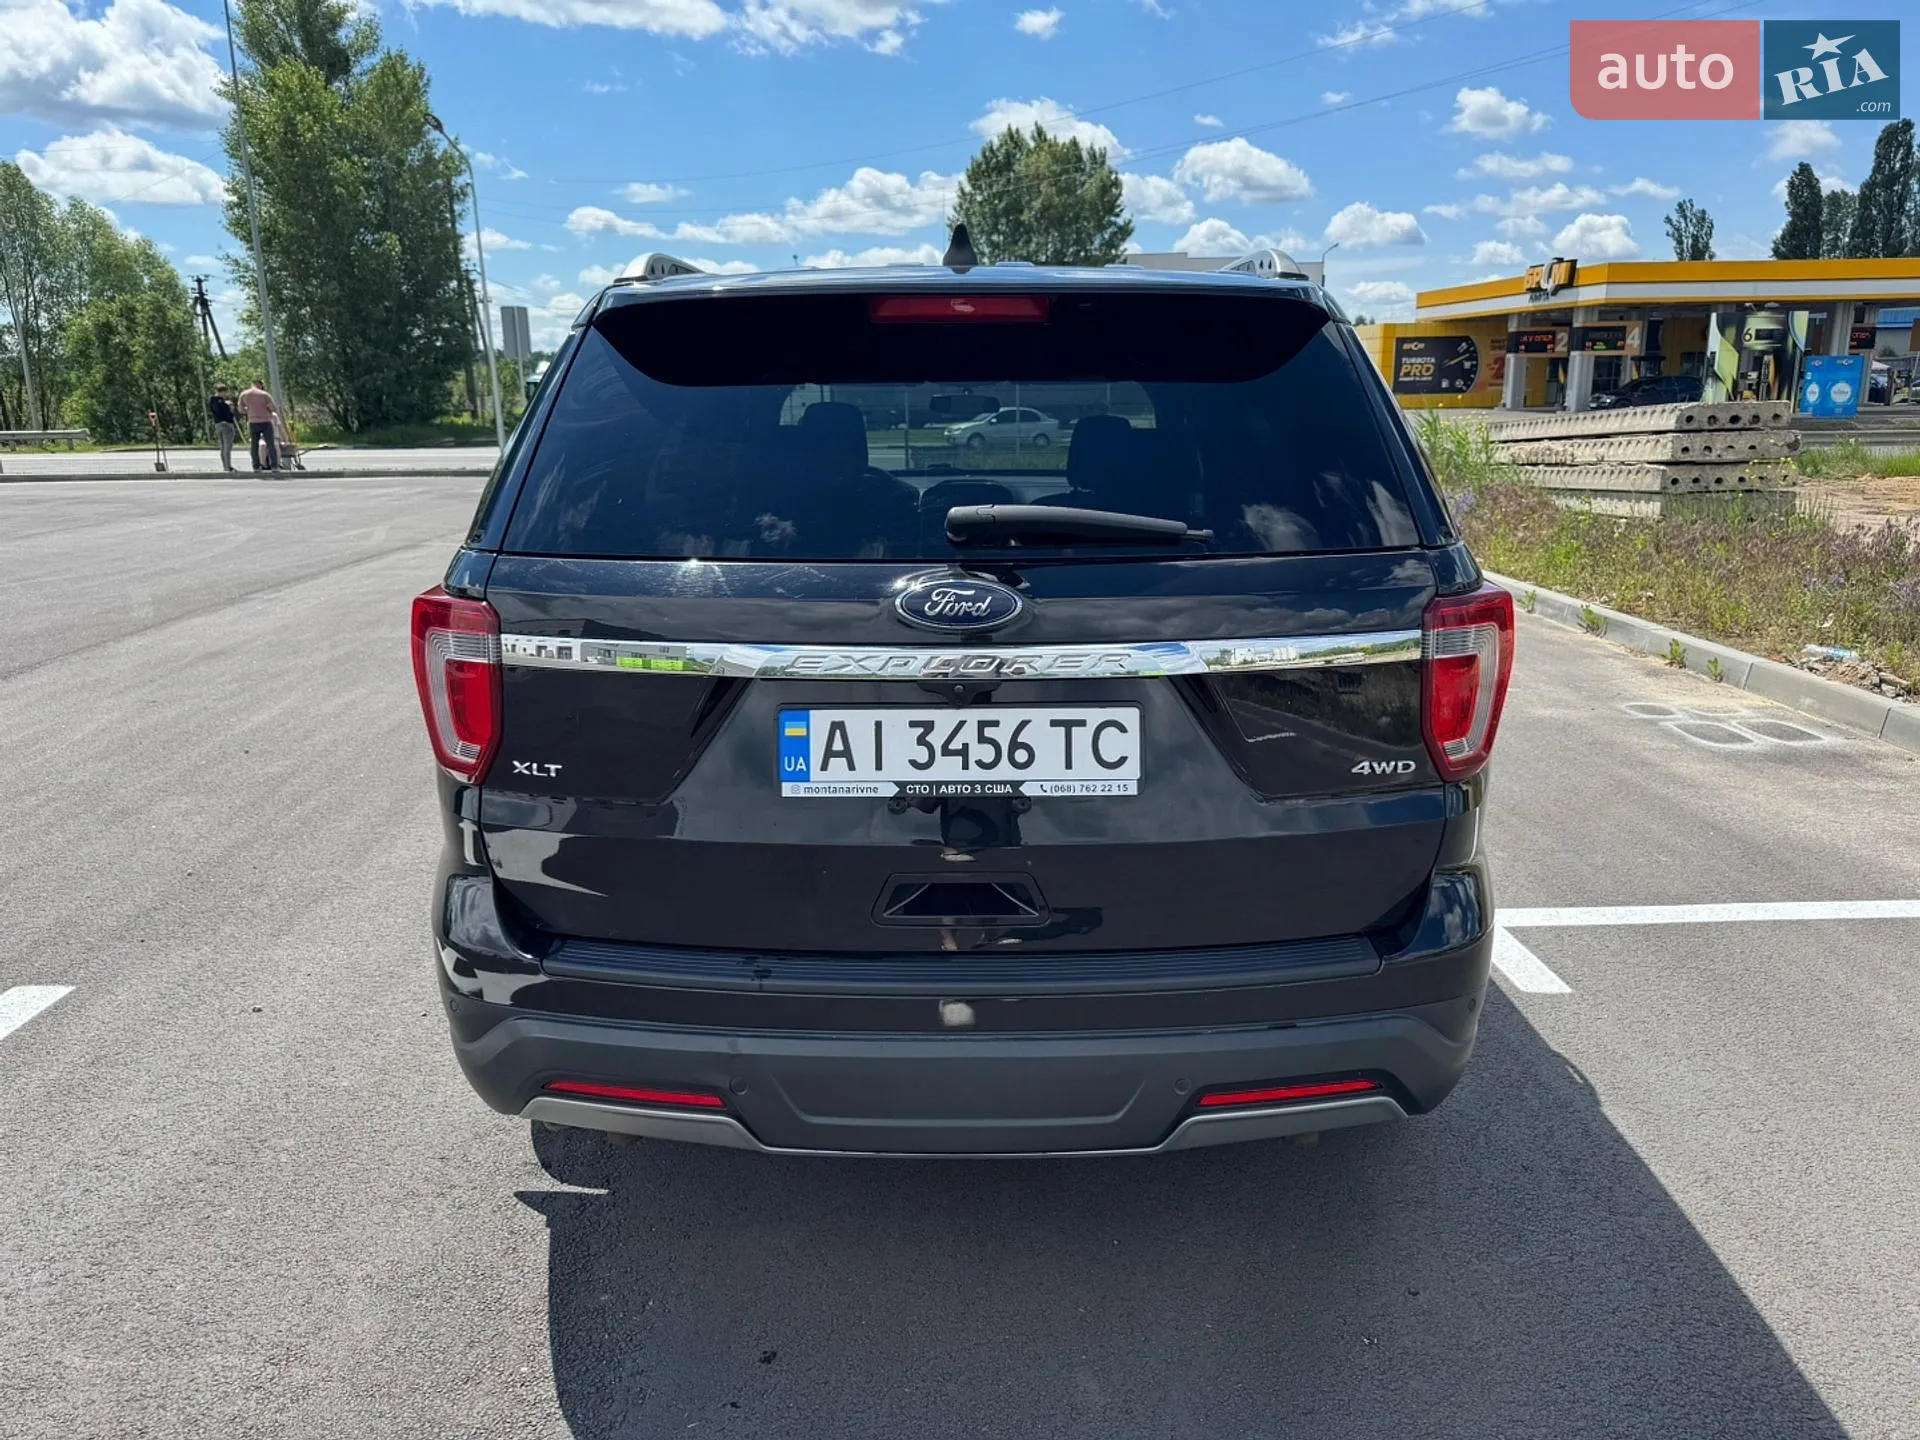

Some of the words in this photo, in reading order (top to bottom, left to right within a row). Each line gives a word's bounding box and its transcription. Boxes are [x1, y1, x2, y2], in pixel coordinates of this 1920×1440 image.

[1555, 332, 1568, 352] 2
[1626, 326, 1640, 349] 4
[1743, 327, 1753, 342] 6
[1400, 364, 1435, 377] PRO
[924, 588, 992, 616] Ford
[786, 652, 1133, 676] EXPLORER
[819, 720, 883, 771] AI
[908, 719, 1036, 771] 3456
[1049, 719, 1129, 770] TC
[512, 760, 563, 777] XLT
[784, 756, 807, 772] UA
[1351, 760, 1416, 775] 4WD
[803, 784, 879, 795] montanarivne
[906, 784, 930, 794] СТО
[939, 784, 972, 794] АВТО
[985, 784, 1013, 794] США
[1050, 783, 1076, 793] (068)
[1079, 783, 1098, 792] 762
[1100, 783, 1113, 792] 22
[1117, 783, 1129, 792] 15
